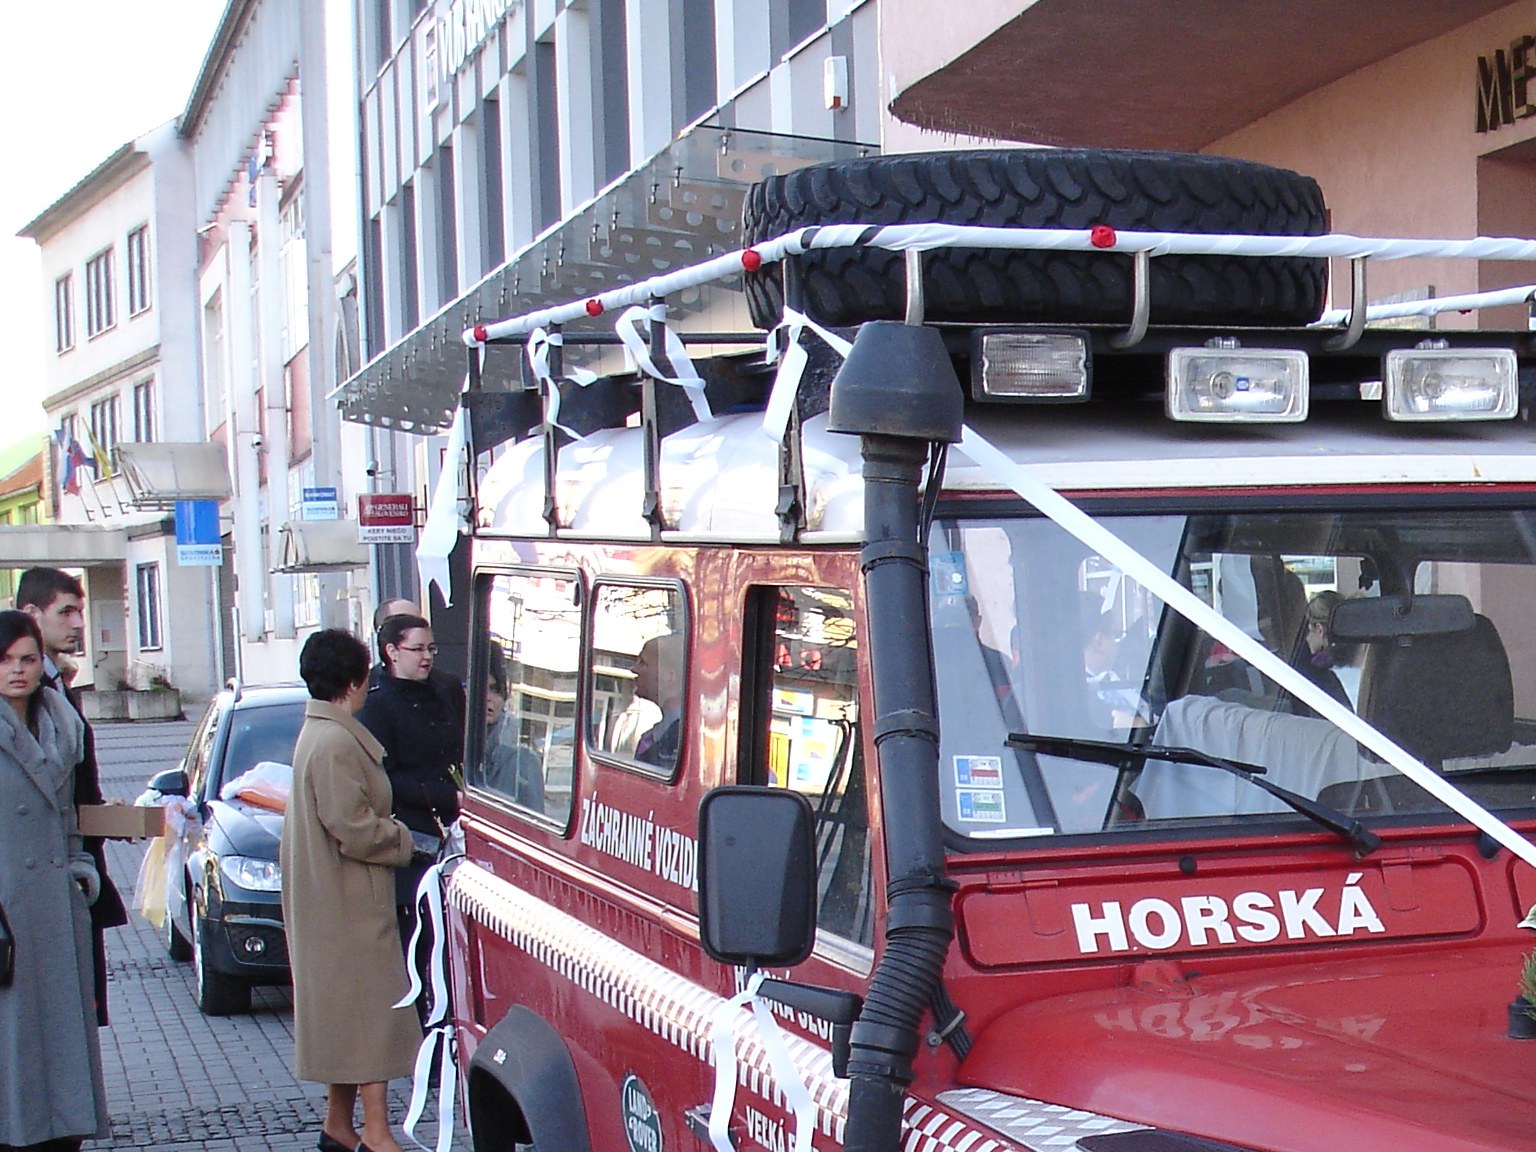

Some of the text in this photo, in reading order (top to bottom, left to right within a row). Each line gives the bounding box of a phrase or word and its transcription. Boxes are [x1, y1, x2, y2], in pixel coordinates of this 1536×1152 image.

[581, 790, 699, 893] ZÁCHRANNÉ VOZIDL
[1071, 872, 1385, 953] HORSKÁ
[628, 1086, 652, 1121] LAND
